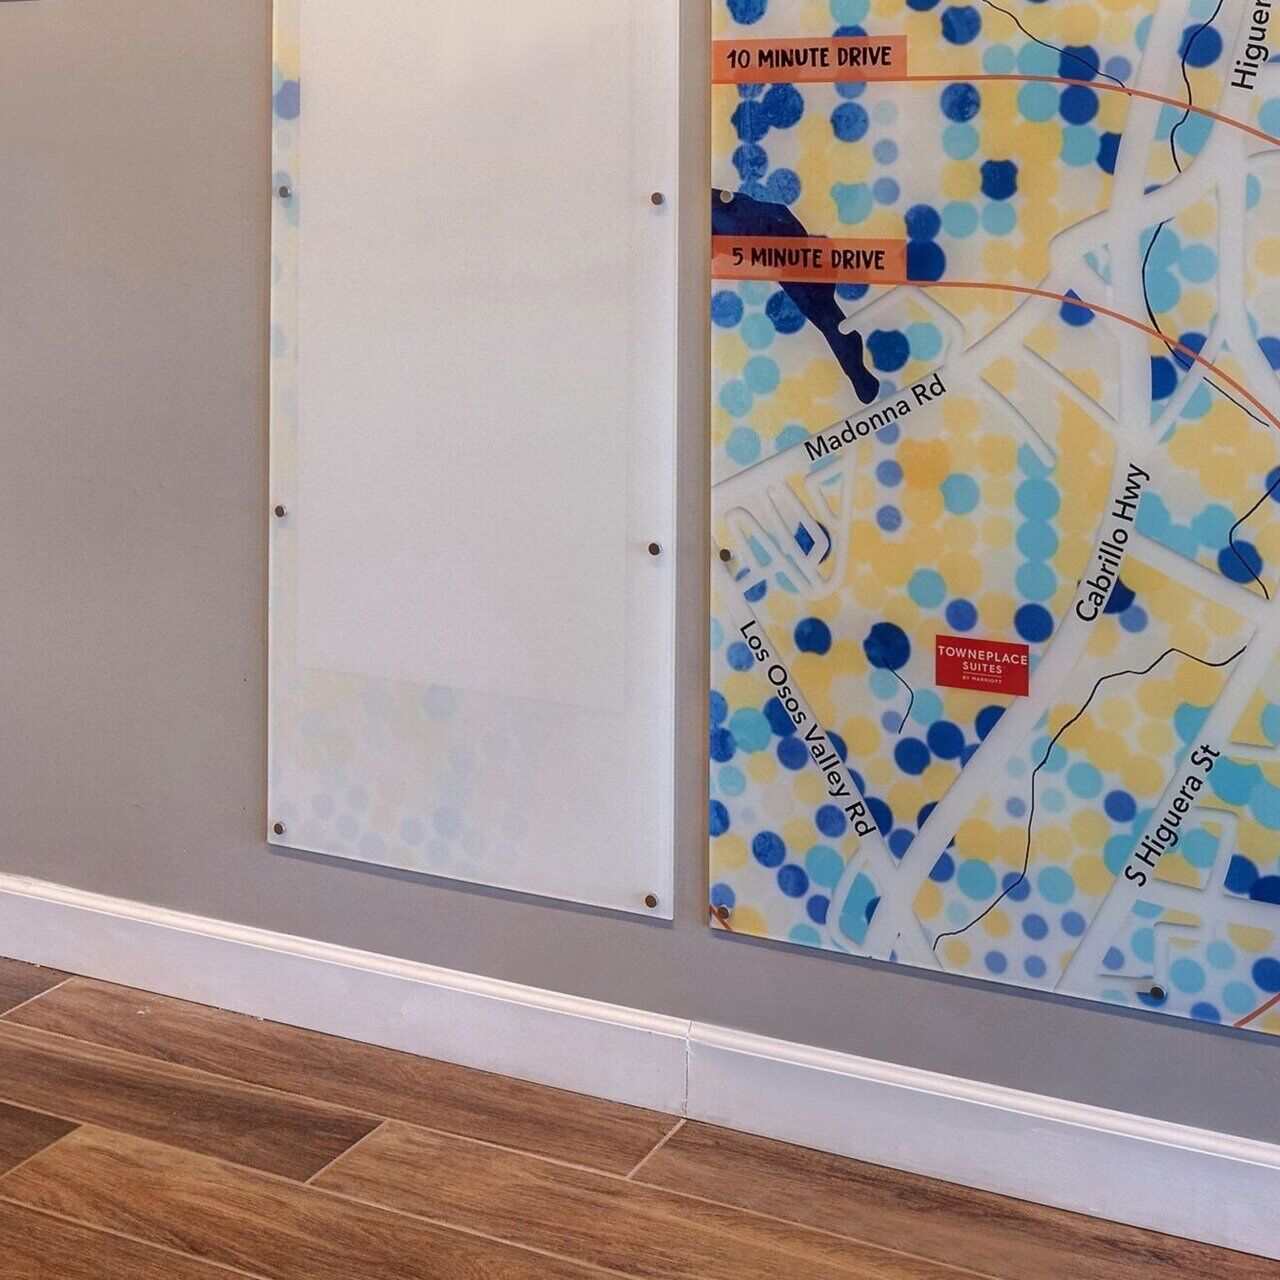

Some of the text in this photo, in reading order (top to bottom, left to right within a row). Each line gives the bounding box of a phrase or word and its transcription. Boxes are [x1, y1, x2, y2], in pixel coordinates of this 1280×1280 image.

[726, 46, 892, 69] 10 MINUTE DRIVE
[732, 248, 886, 270] 5 MINUTE DRIVE
[804, 374, 948, 462] Madonna Rd
[1075, 462, 1150, 622] Cabrillo Hwy
[938, 645, 1028, 665] TOWNEPLACE
[962, 661, 1002, 674] SUITES
[739, 620, 877, 837] Los Osos Valley Rd
[1124, 744, 1220, 888] S Higuera St
